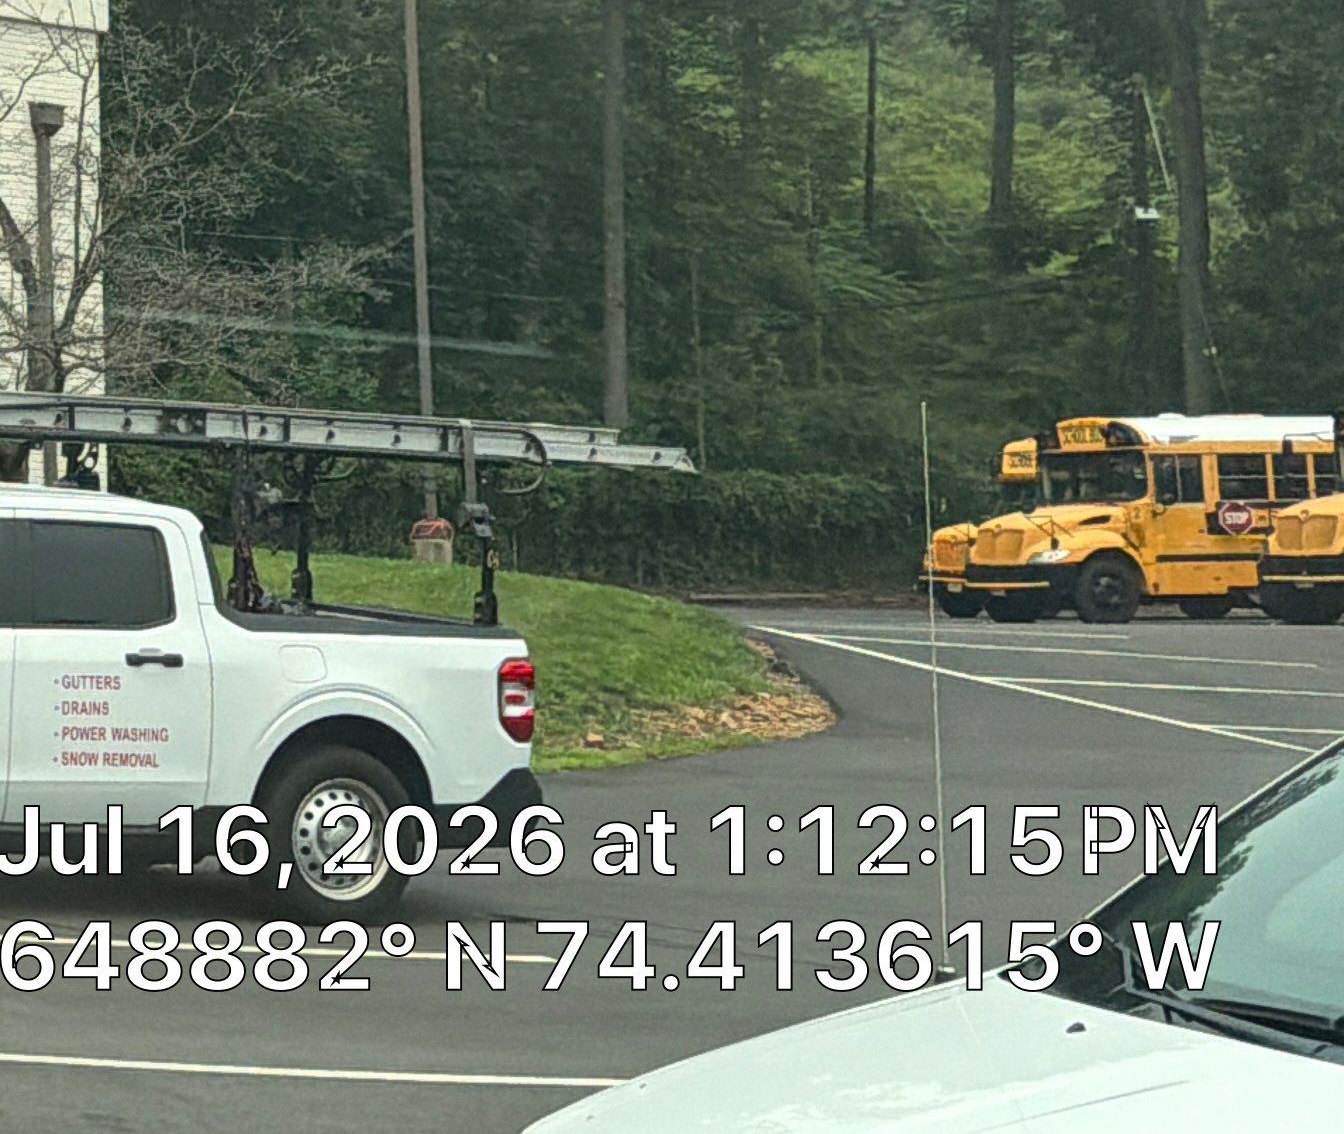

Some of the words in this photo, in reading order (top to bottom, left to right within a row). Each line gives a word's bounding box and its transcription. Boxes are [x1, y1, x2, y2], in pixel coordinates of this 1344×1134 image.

[1224, 512, 1249, 525] STOP
[61, 674, 122, 691] GUTTERS
[61, 700, 110, 716] DRAINS
[61, 726, 107, 742] POWER
[111, 727, 170, 743] WASHING
[61, 751, 100, 767] SNOW
[102, 752, 160, 768] REMOVAL
